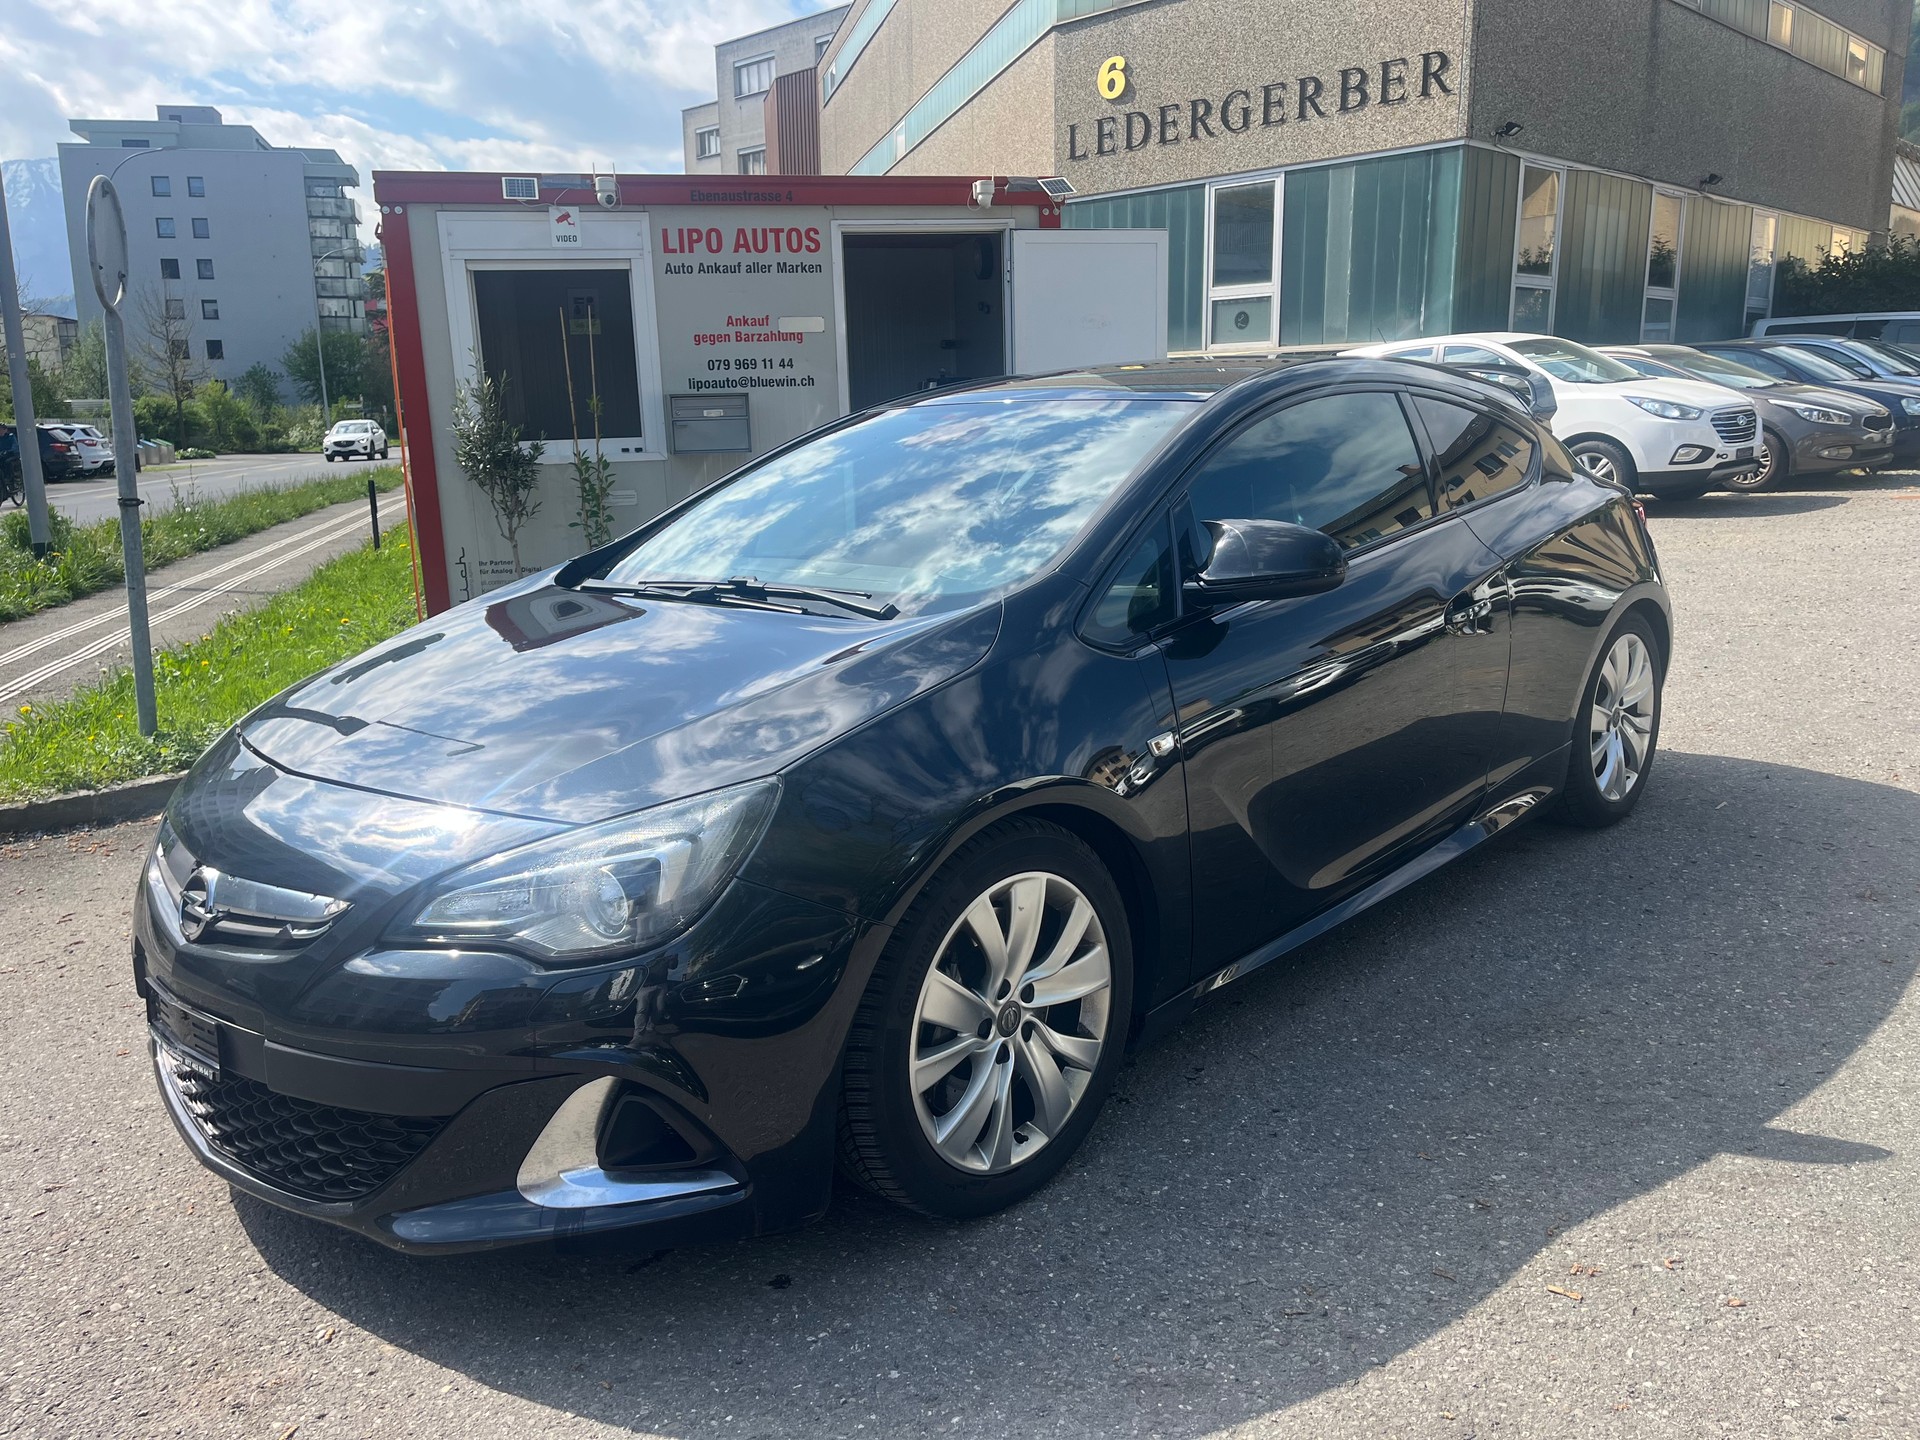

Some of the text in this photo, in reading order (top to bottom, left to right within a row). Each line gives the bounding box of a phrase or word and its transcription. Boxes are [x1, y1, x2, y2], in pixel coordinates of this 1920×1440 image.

[1096, 55, 1126, 100] 6
[1067, 50, 1457, 161] LEDERGERBER
[690, 189, 793, 202] Ebenaustrasse 4
[555, 234, 578, 243] VIDEO
[661, 227, 821, 254] LIPO AUTOS
[665, 261, 823, 275] Auto Ankauf aller Marken
[726, 315, 770, 327] Ankauf
[693, 331, 804, 346] gegen Barzahlung
[707, 358, 794, 371] 079 969 11 44
[688, 375, 815, 392] lipoauto@bluewin.ch
